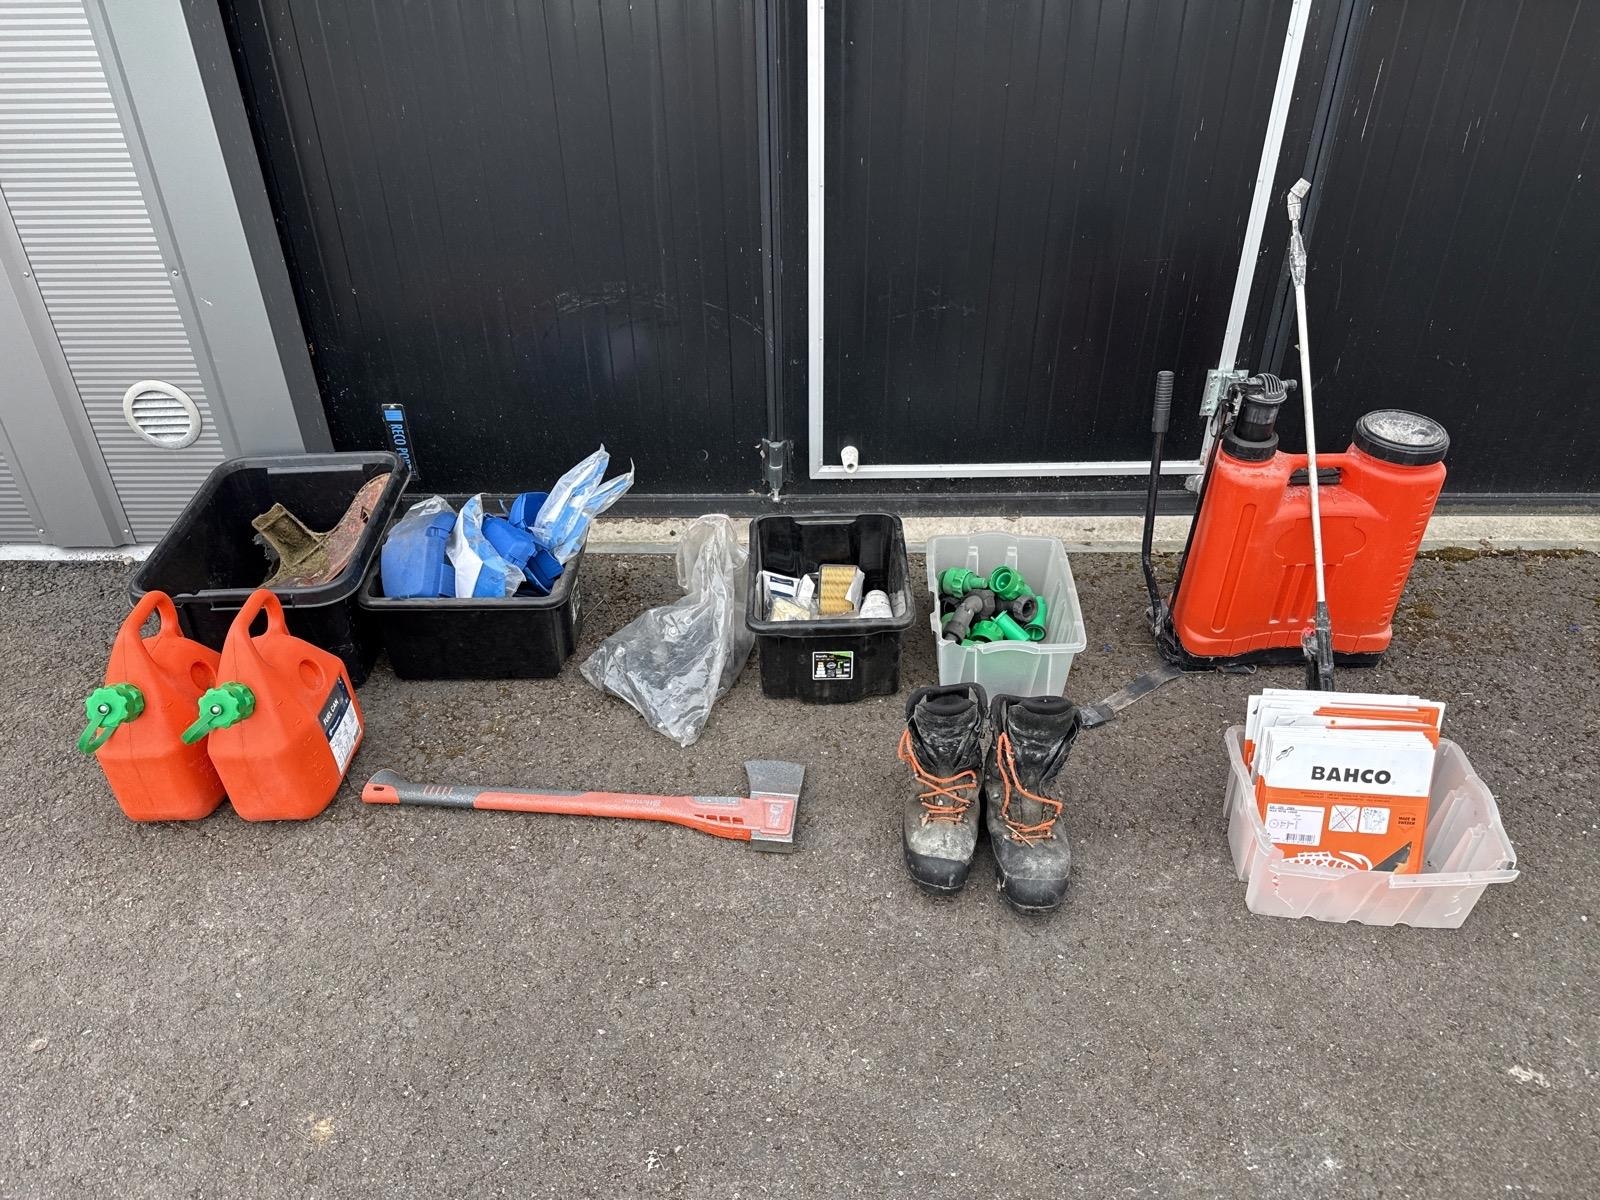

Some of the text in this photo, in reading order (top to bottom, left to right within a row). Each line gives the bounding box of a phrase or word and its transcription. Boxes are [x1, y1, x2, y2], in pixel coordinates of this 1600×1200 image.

[391, 424, 406, 445] RECO
[323, 711, 333, 726] FUEL
[330, 699, 340, 713] CAN
[1310, 766, 1392, 785] BAHCO
